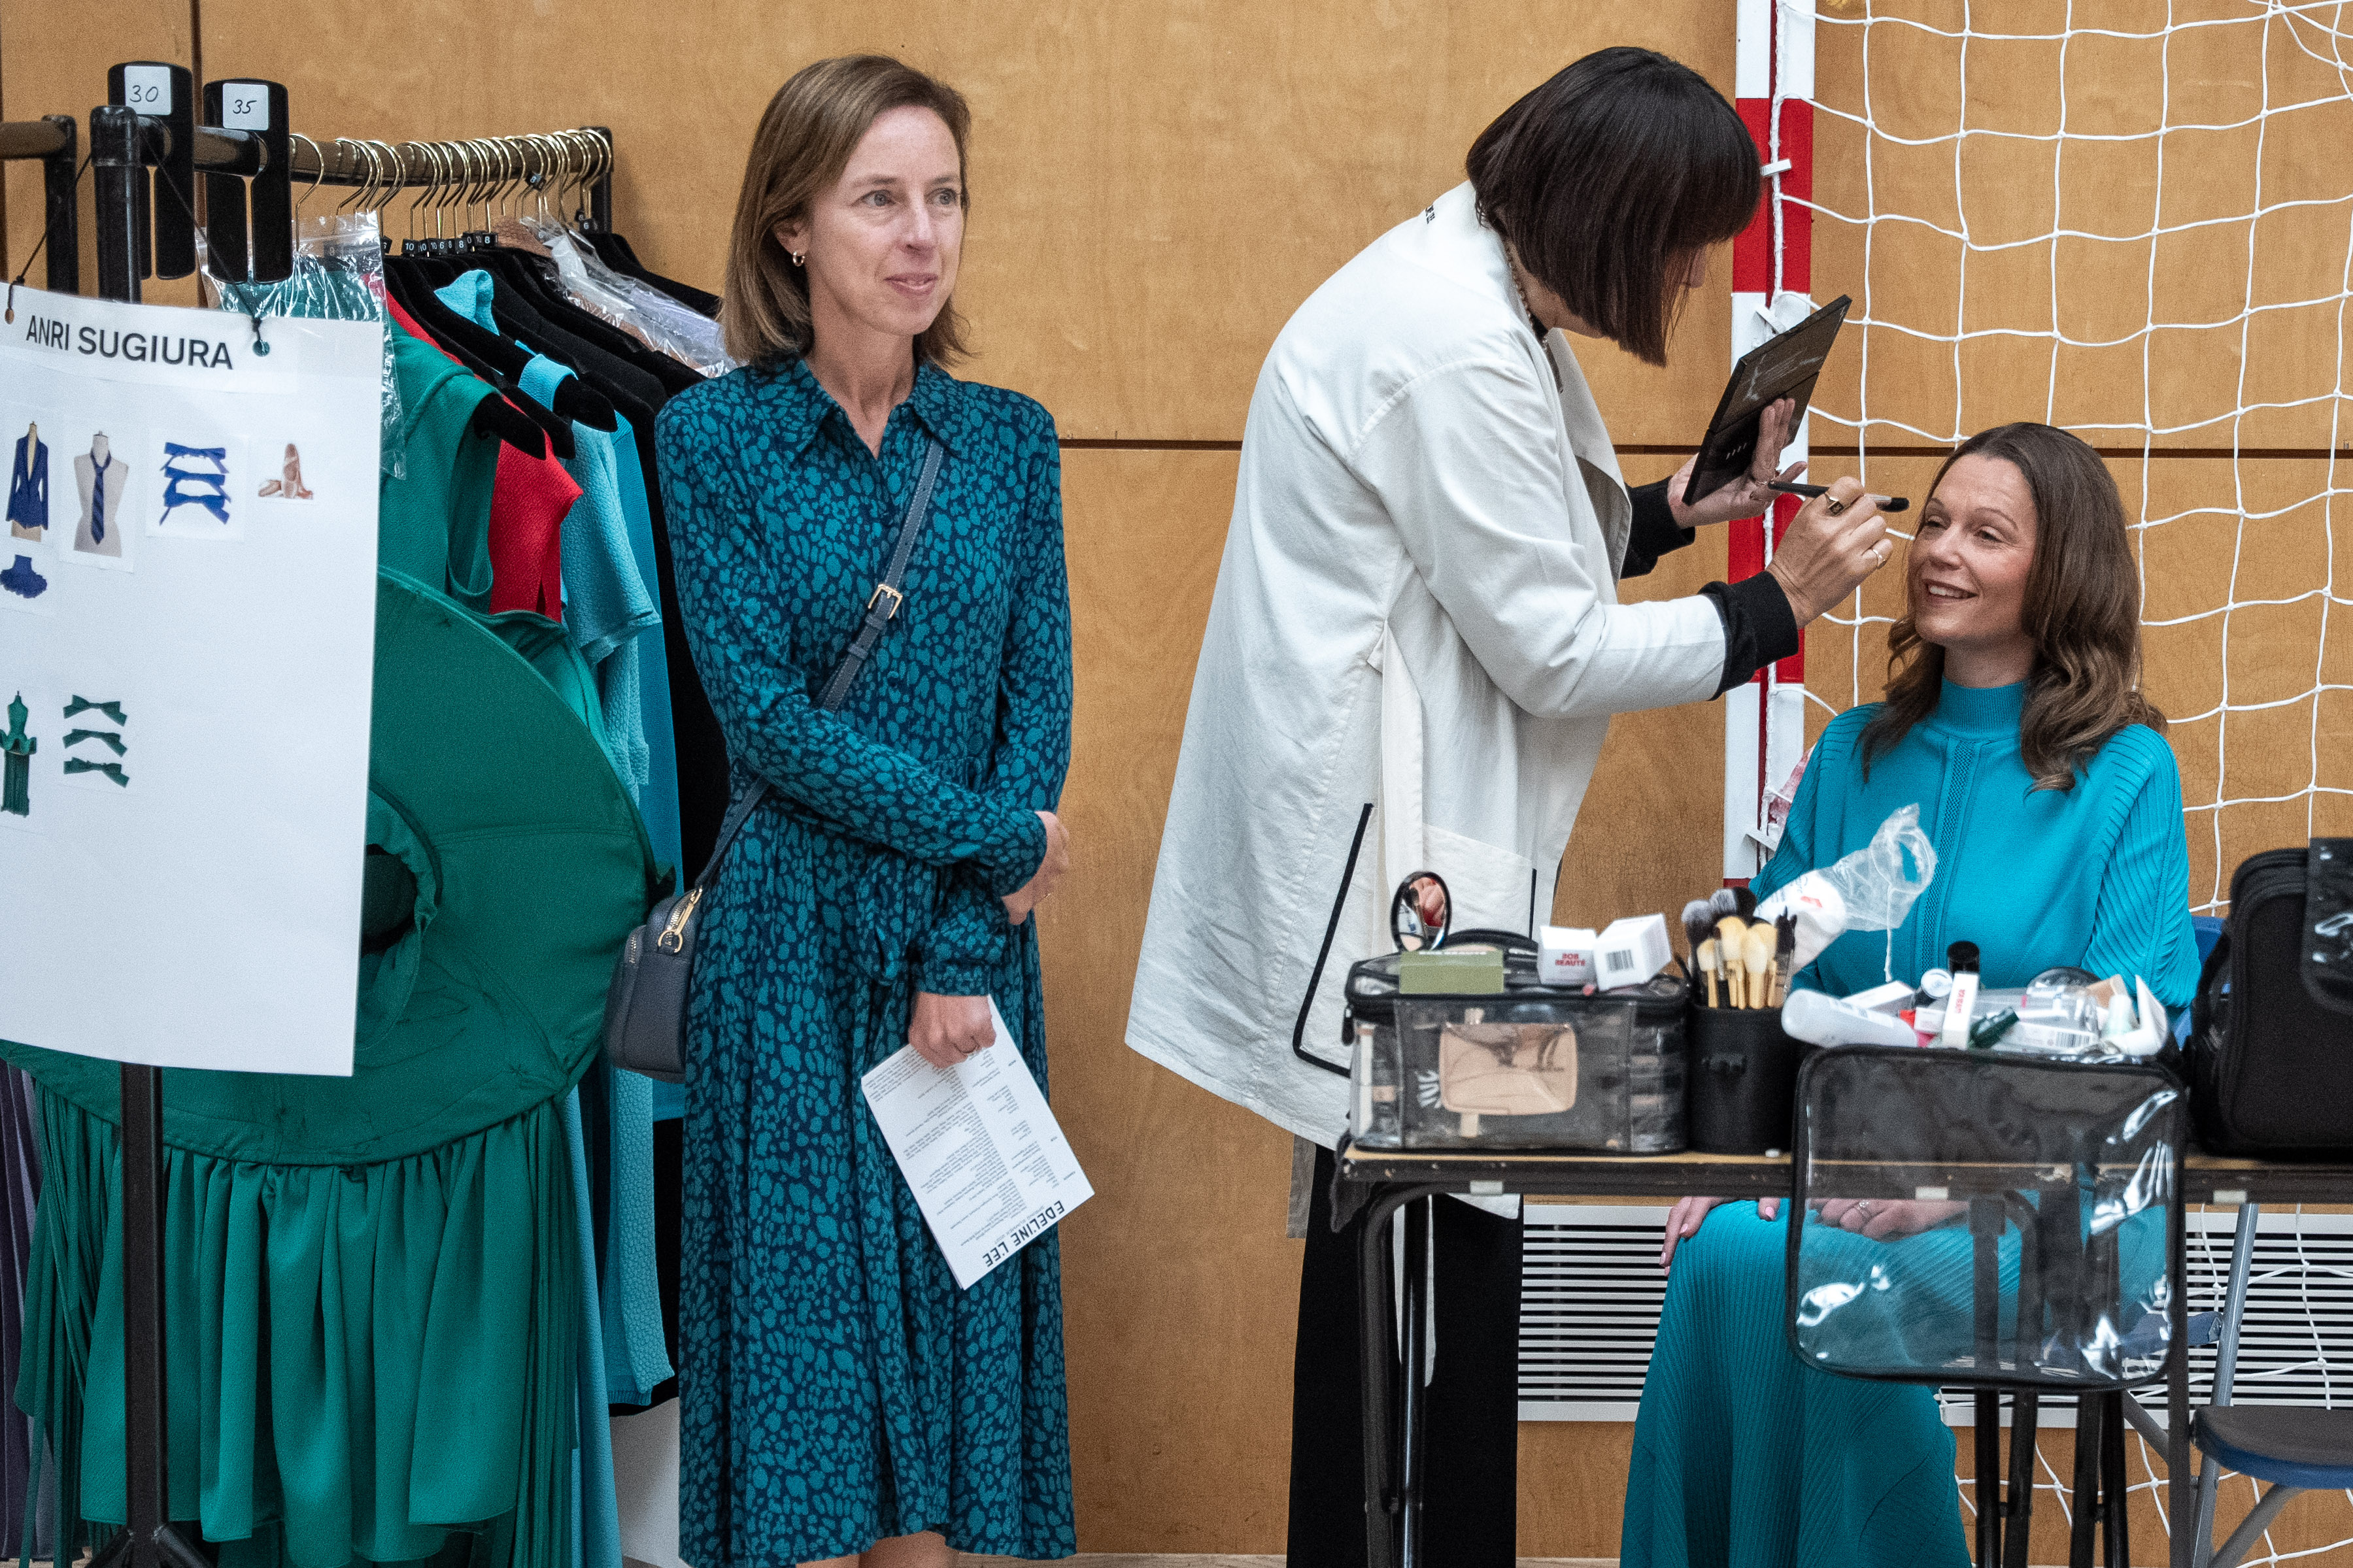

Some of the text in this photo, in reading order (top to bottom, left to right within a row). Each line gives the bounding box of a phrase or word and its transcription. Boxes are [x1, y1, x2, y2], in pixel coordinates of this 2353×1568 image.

[129, 86, 159, 103] 30
[232, 99, 257, 115] 35
[405, 242, 415, 251] 10
[420, 243, 427, 252] 10
[439, 241, 445, 250] 6
[26, 314, 233, 371] ANRI SUGIURA
[1009, 1199, 1065, 1246] EDELINE
[981, 1241, 1009, 1267] LEE
